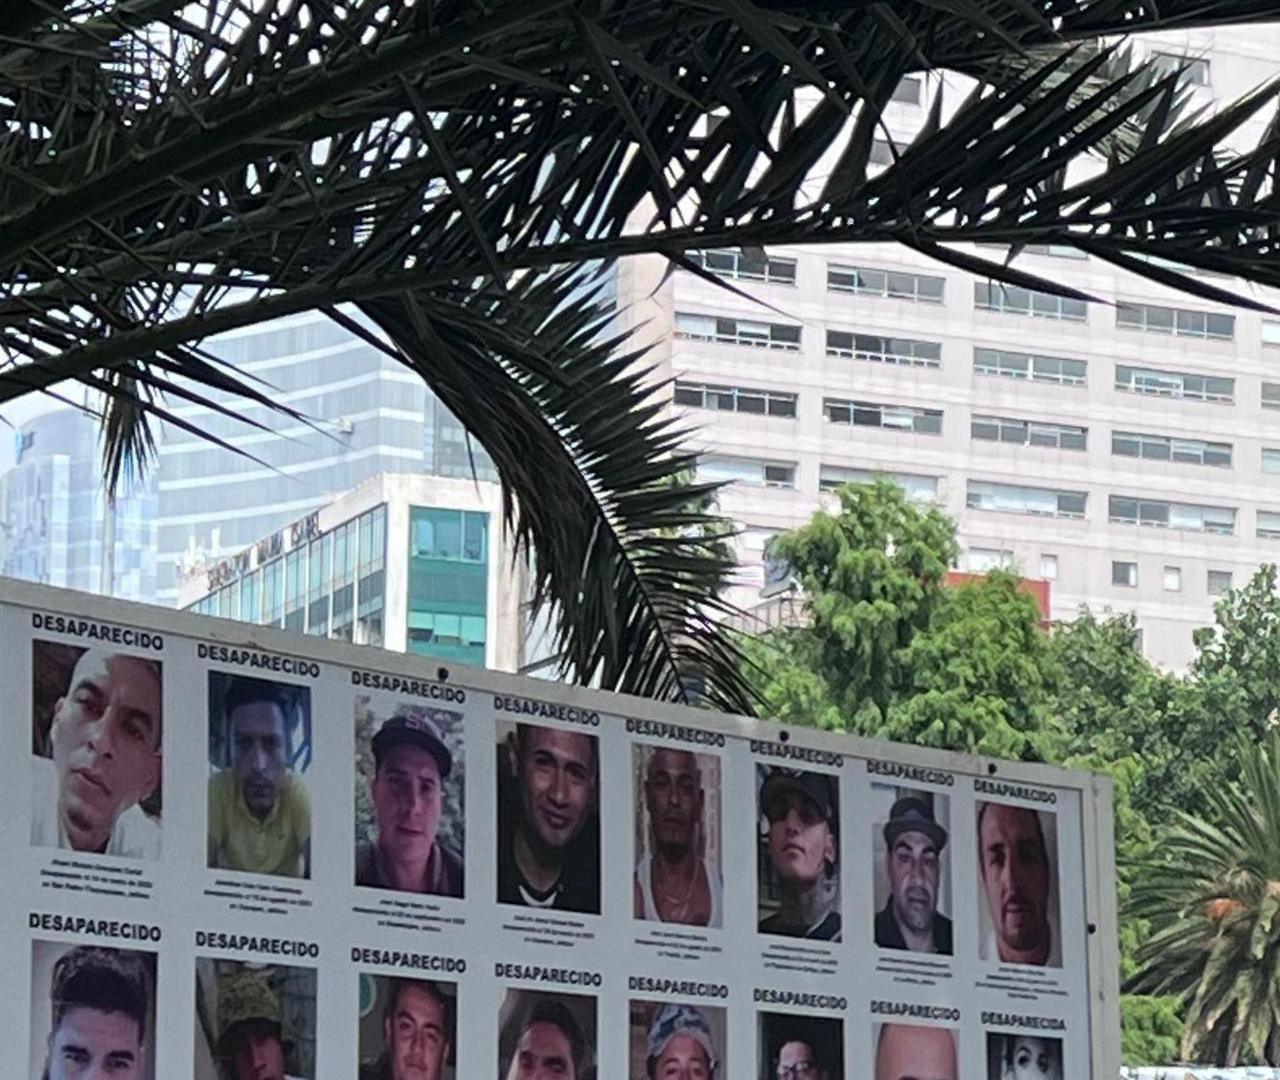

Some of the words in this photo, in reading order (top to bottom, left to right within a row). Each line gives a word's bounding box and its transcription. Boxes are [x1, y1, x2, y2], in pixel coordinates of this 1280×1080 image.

[32, 613, 163, 650] DESAPARECIDO
[198, 643, 320, 678] DESAPARECIDO
[352, 671, 465, 704] DESAPARECIDO
[494, 695, 599, 728] DESAPARECIDO
[626, 719, 725, 748] DESAPARECIDO
[750, 740, 843, 768] DESAPARECIDO
[866, 759, 954, 787] DESAPARECIDO
[974, 779, 1056, 804] DESAPARECIDO
[29, 913, 161, 943] DESAPARECIDO
[195, 931, 319, 958] DESAPARECIDO
[351, 947, 466, 974] DESAPARECIDO
[495, 962, 601, 987] DESAPARECIDO
[628, 975, 728, 999] DESAPARECIDO
[753, 987, 847, 1011] DESAPARECIDO
[870, 999, 960, 1022] DESAPARECIDO
[981, 1010, 1067, 1032] DESAPARECIDA
